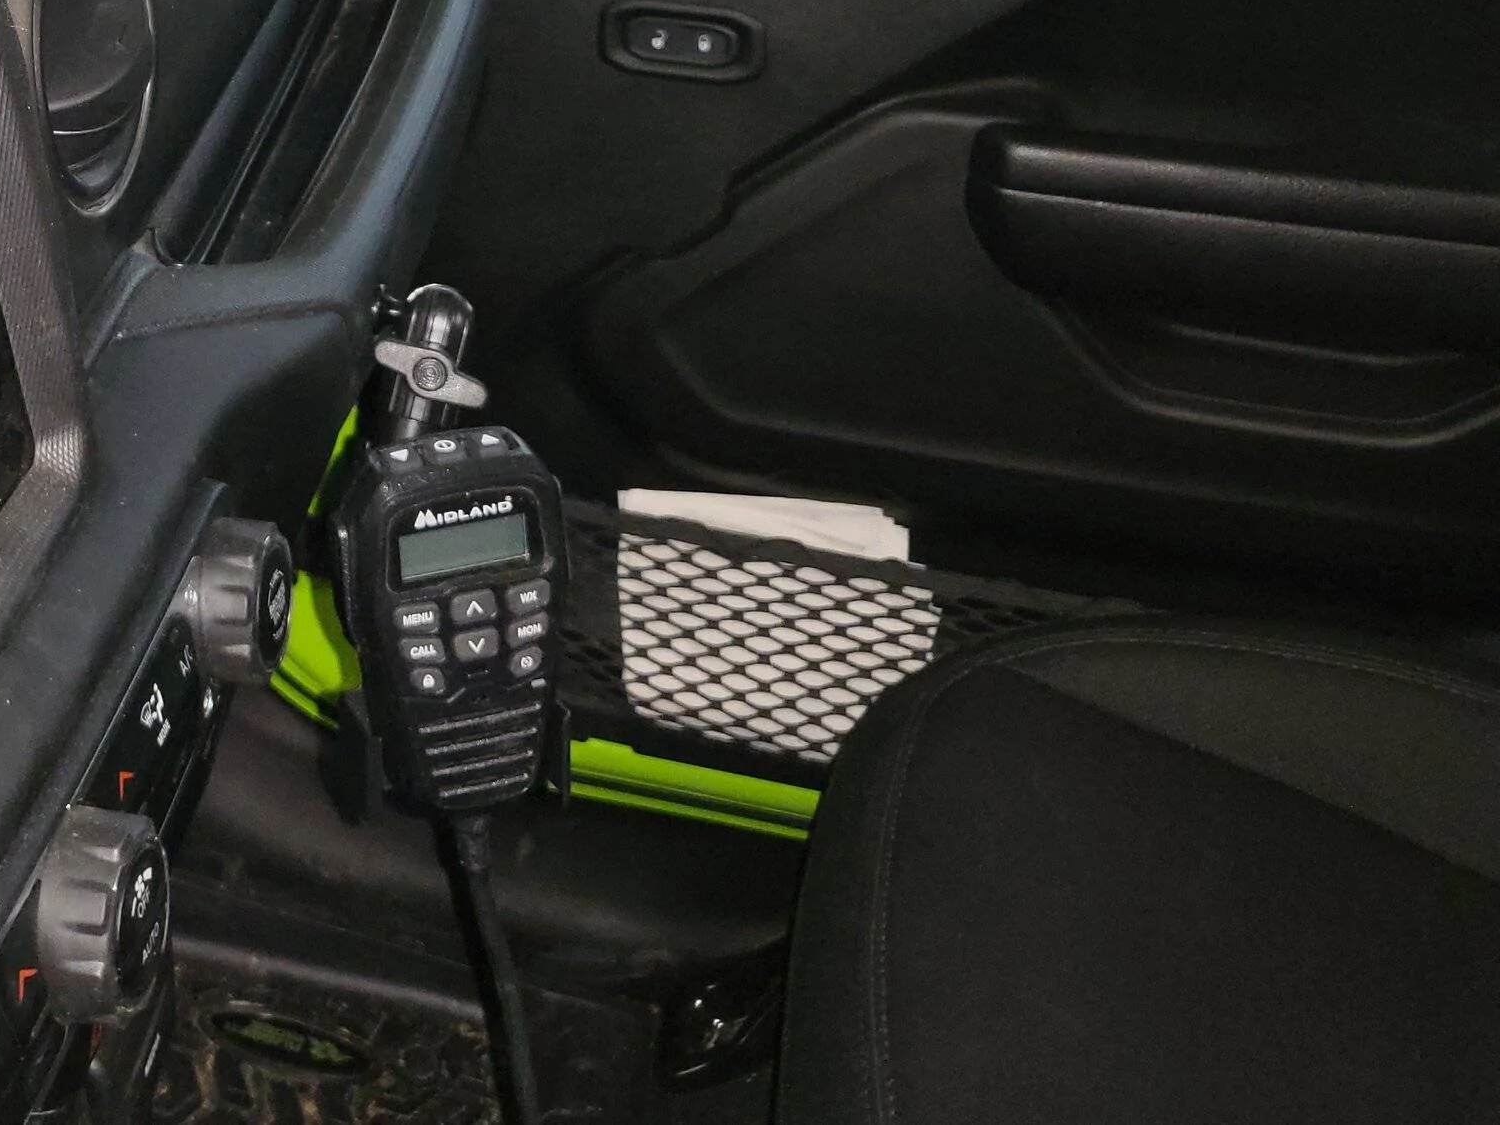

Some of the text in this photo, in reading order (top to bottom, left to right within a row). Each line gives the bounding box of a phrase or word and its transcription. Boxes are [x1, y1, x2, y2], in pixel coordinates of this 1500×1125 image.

[414, 500, 513, 530] MIDLAND
[520, 590, 538, 604] WX
[403, 610, 433, 627] MENU
[517, 623, 542, 638] MON
[410, 644, 437, 660] CALL
[142, 921, 160, 966] AUTO
